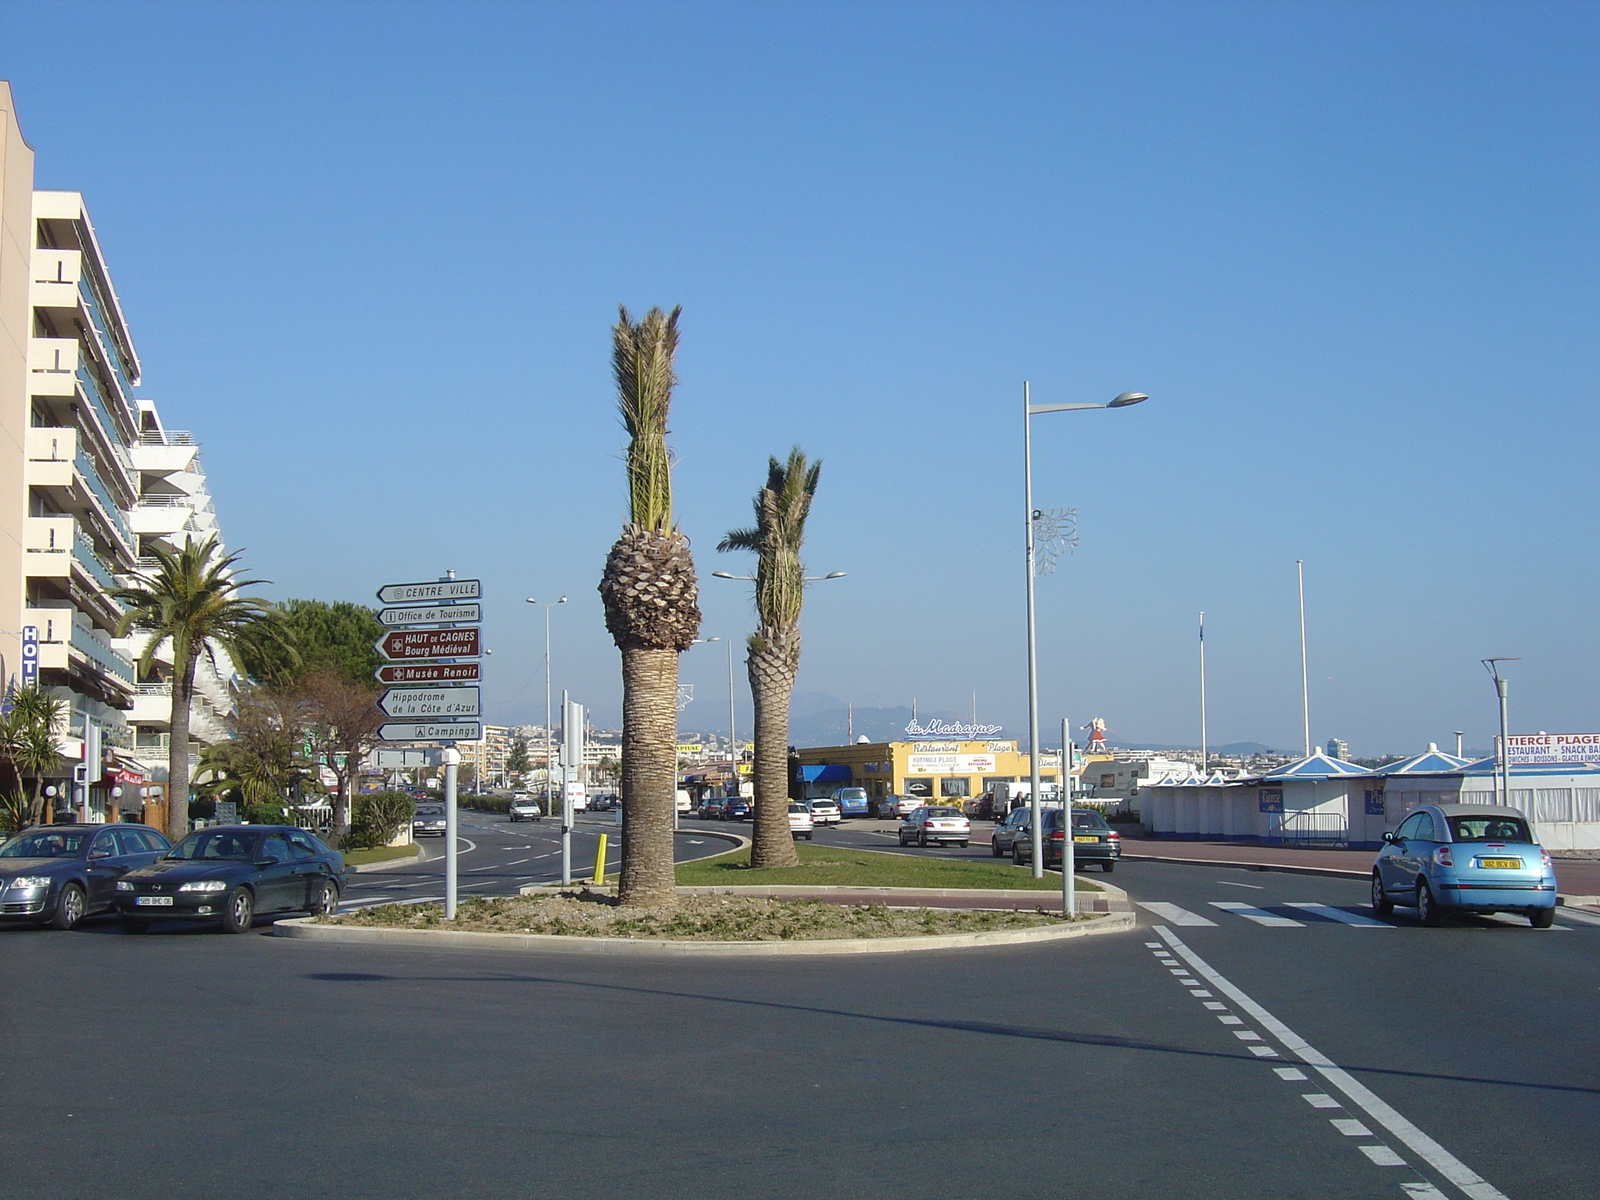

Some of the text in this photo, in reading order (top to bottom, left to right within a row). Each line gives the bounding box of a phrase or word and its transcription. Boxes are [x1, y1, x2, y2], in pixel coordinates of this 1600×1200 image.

[406, 586, 443, 598] CENTRE
[398, 609, 475, 621] Office de Tourisme
[405, 634, 429, 644] HAUT
[439, 631, 475, 643] CAGNES
[405, 643, 471, 657] Bourg Médiéval
[23, 627, 37, 690] HOTE
[406, 668, 477, 679] Musée Renoir
[392, 692, 445, 703] Hippodrome
[392, 703, 476, 714] de la Côte d'Azur
[427, 726, 475, 738] Campings
[1557, 735, 1600, 745] PLAGE
[913, 741, 1011, 753] Restaurant Plage
[1507, 746, 1551, 755] ESTAURANT
[1561, 745, 1588, 755] SNACK
[1533, 755, 1558, 763] BOISSONS
[1561, 754, 1580, 762] GLACES
